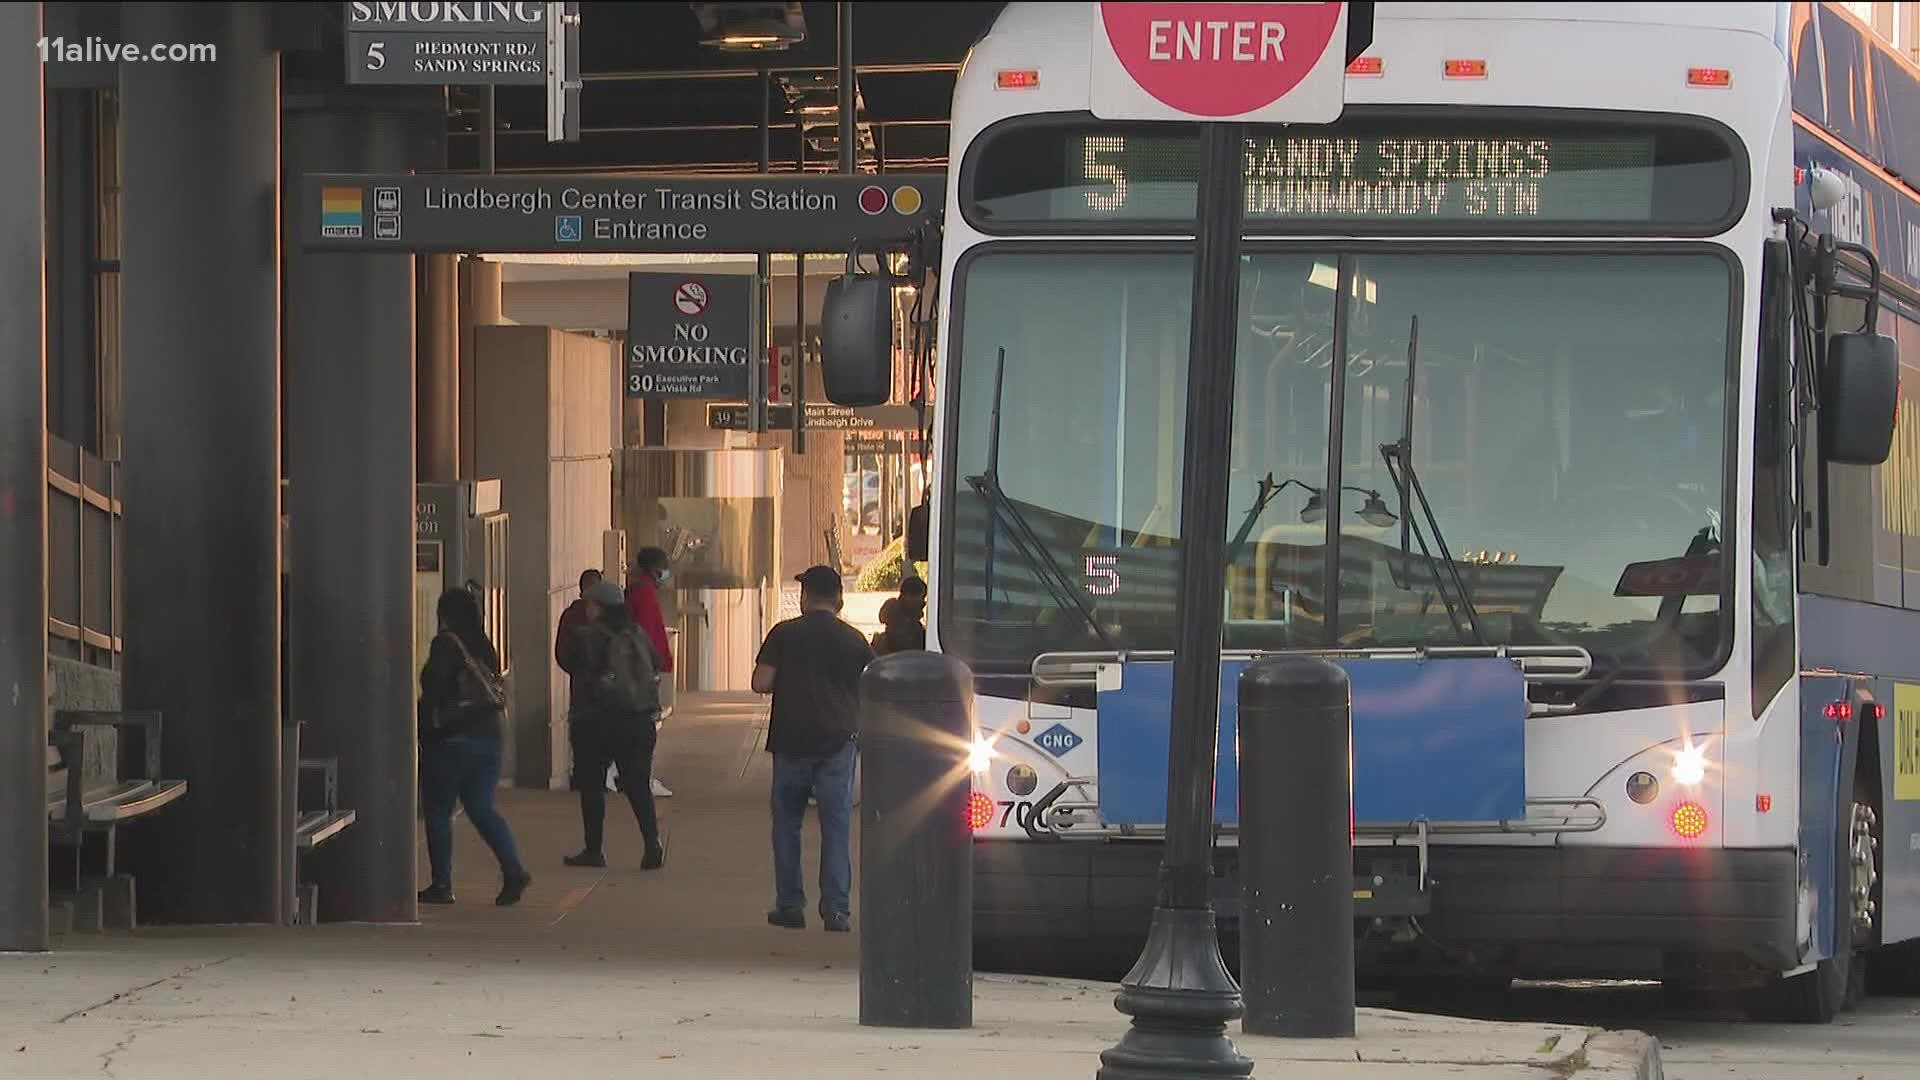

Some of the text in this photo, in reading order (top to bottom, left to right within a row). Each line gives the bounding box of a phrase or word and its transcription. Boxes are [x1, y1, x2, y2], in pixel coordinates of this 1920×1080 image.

[351, 2, 543, 23] SMOKING
[415, 41, 501, 56] PIEDMONT
[1148, 20, 1287, 63] ENTER
[367, 42, 386, 70] 5
[414, 59, 542, 73] SANDY SPRINGS
[1244, 138, 1551, 178] SANDY SPRINGS
[1083, 134, 1128, 212] 5
[424, 187, 838, 215] Lindbergh Center Transit Station
[1246, 180, 1539, 215] DUNWOODY STN
[324, 226, 361, 237] marta
[593, 218, 708, 240] Entrance
[674, 322, 709, 342] NO
[631, 345, 748, 365] SMOKING
[629, 374, 653, 393] 30
[655, 384, 702, 393] LaVista Rd
[656, 375, 720, 383] Executive Park
[805, 417, 874, 428] indbergh Drive
[827, 408, 855, 417] Street
[1084, 554, 1120, 597] 5
[1042, 734, 1074, 748] CNG
